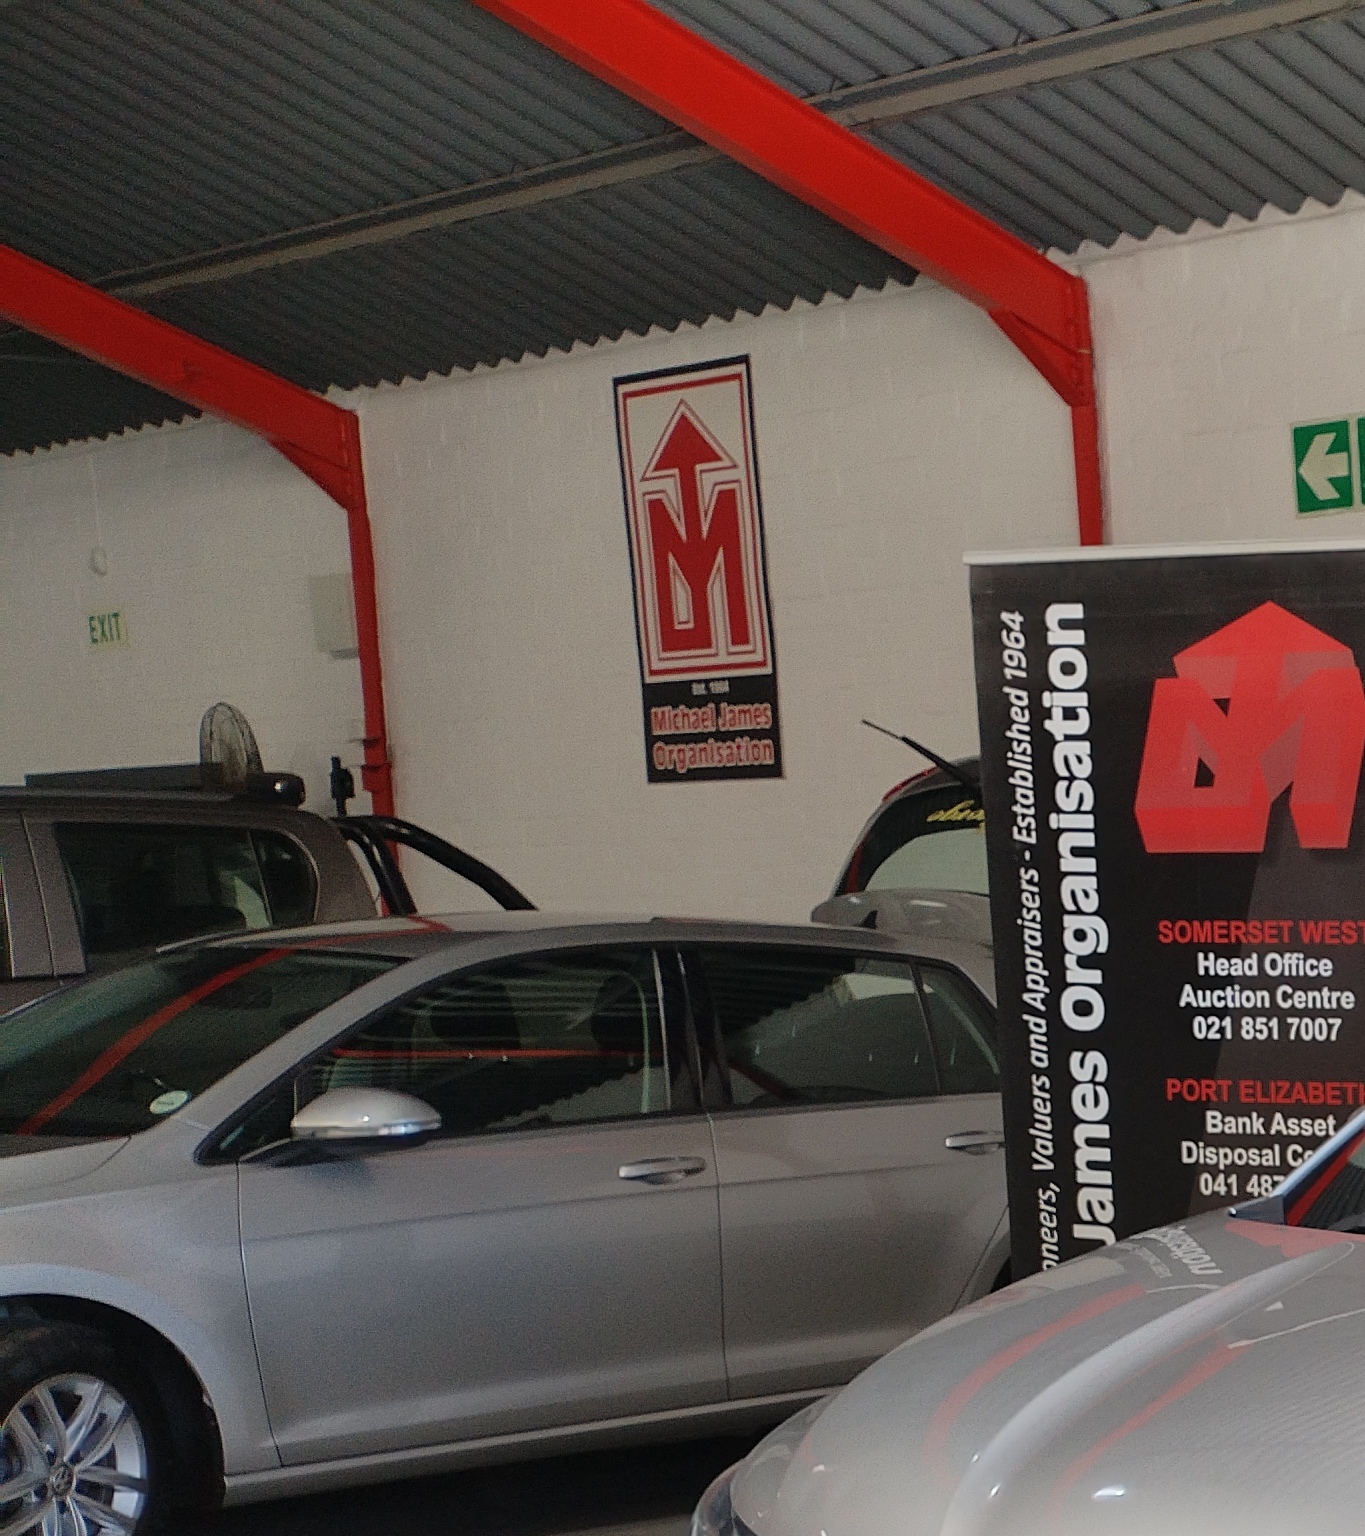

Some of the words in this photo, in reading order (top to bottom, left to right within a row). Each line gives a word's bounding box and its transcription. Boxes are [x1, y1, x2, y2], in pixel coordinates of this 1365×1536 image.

[88, 612, 120, 644] EXIT
[1000, 610, 1028, 680] 1964
[651, 703, 716, 735] Michael
[718, 702, 772, 731] James
[653, 736, 775, 773] Organisation
[1002, 685, 1037, 845] Established
[1042, 602, 1109, 1032] Organisation
[1016, 867, 1050, 1011] Appraisers
[1158, 920, 1294, 944] SOMERSET
[1197, 952, 1258, 976] Head
[1264, 953, 1333, 977] Office
[1179, 984, 1270, 1008] Auction
[1276, 985, 1355, 1009] Centre
[1022, 1014, 1050, 1068] and
[1192, 1016, 1233, 1040] 021
[1241, 1017, 1280, 1040] 851
[1286, 1017, 1342, 1041] 7007
[1165, 1078, 1233, 1103] PORT
[1028, 1074, 1054, 1171] Valuers
[1205, 1110, 1265, 1134] Bank
[1270, 1112, 1337, 1137] Asset
[1069, 1050, 1116, 1246] James
[1181, 1141, 1280, 1169] Disposal
[1200, 1173, 1238, 1196] 041
